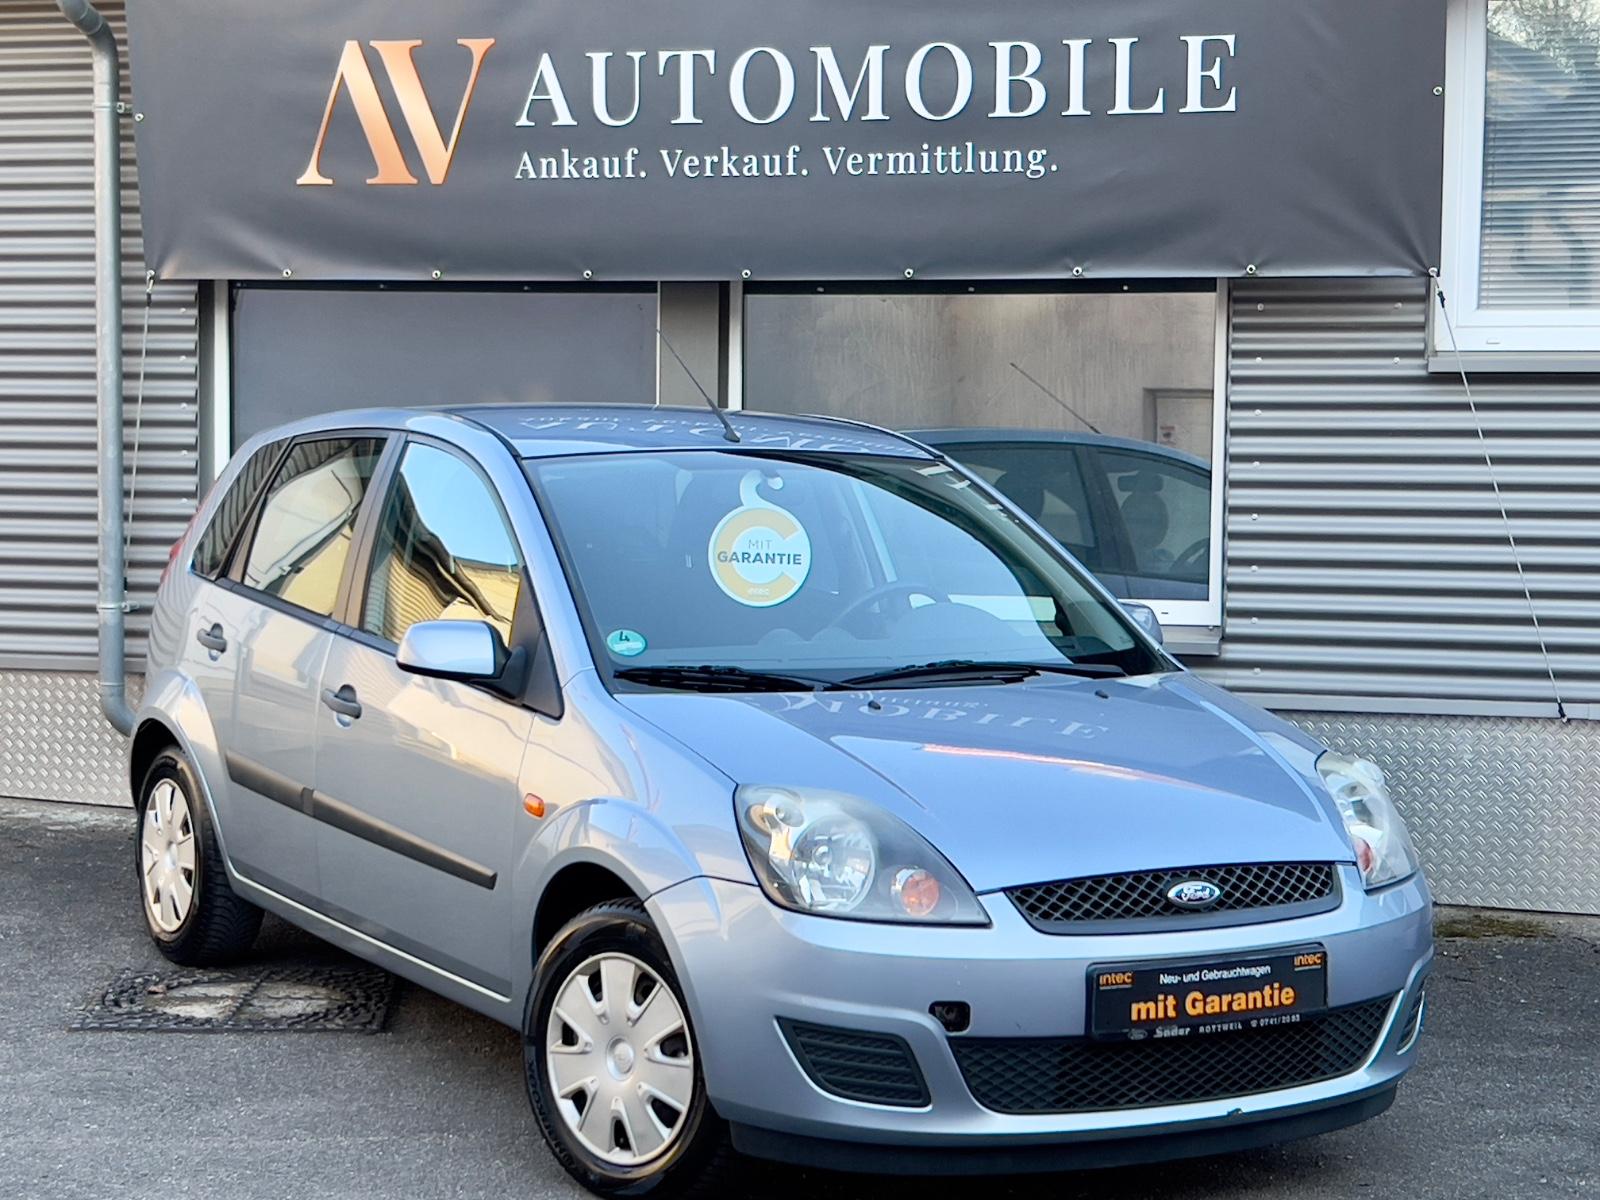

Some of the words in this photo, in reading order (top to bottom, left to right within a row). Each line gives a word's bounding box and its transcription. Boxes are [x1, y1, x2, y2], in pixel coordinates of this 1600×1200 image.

[514, 33, 1238, 128] AUTOMOBILE
[513, 146, 648, 179] Ankauf.
[659, 144, 809, 178] Verkauf.
[821, 142, 1059, 180] Vermittlung.
[747, 538, 773, 550] MIT
[716, 550, 803, 566] GARANTIE
[618, 630, 631, 642] 4
[1295, 953, 1324, 967] intec
[1099, 971, 1134, 986] intec
[1159, 973, 1182, 985] Neu-
[1183, 971, 1200, 983] und
[1201, 965, 1272, 981] Gebrauchtwagen
[1130, 994, 1178, 1022] mit
[1184, 982, 1297, 1018] Garantie
